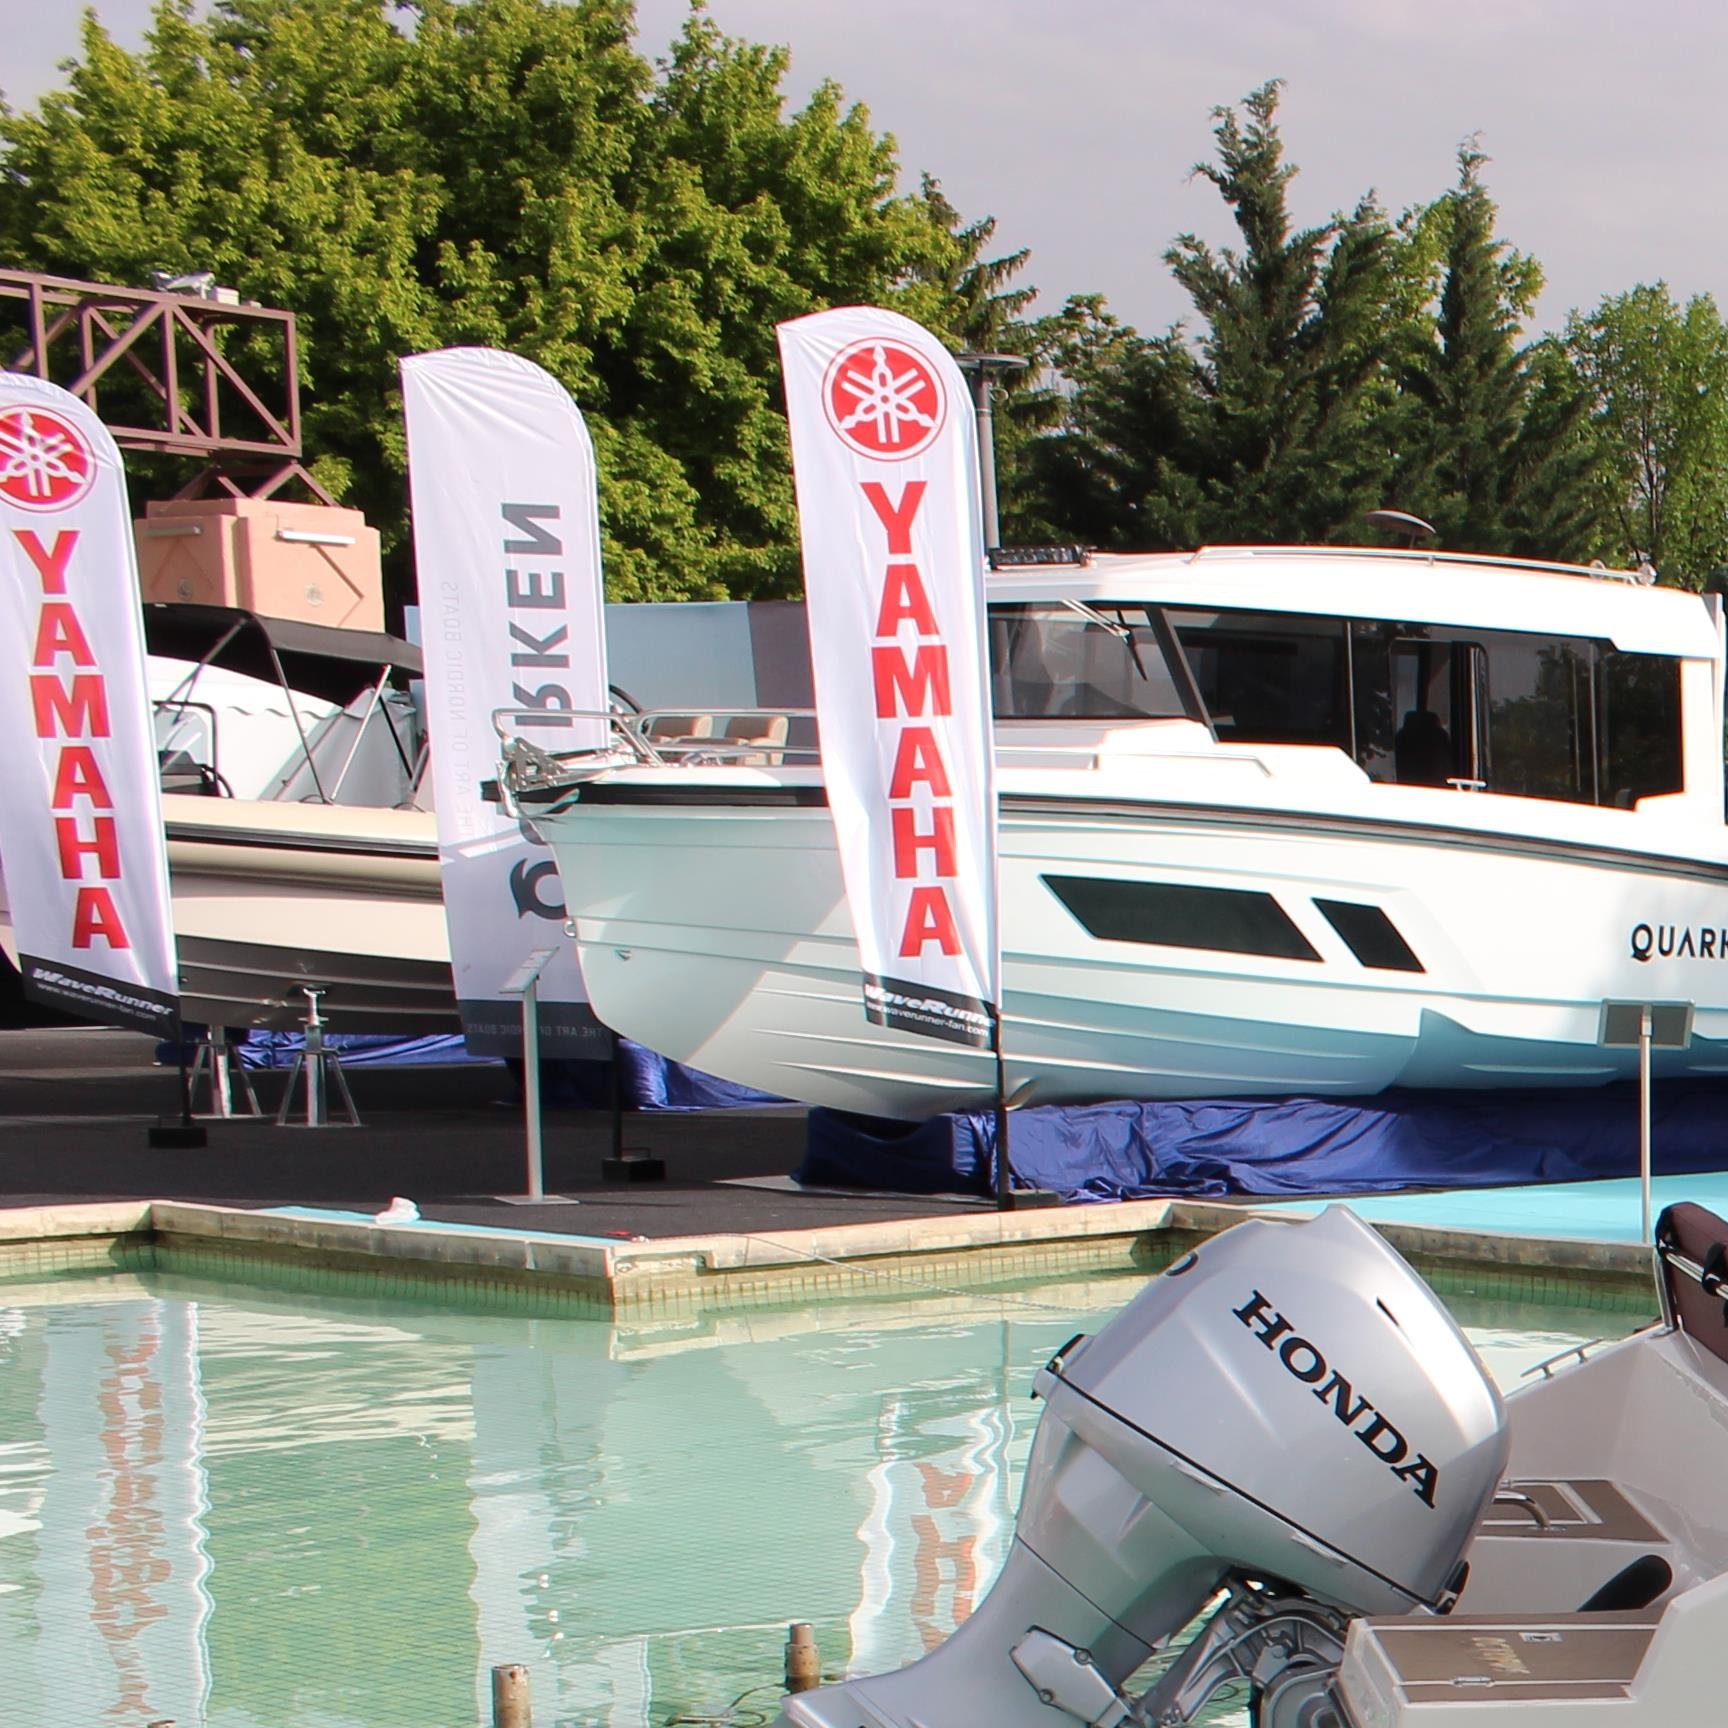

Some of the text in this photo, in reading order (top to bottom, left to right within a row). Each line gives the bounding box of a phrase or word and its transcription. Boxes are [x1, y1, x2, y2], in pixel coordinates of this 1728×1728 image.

[14, 530, 129, 949] YAMAHA
[861, 481, 961, 957] YAMAHA
[1232, 1290, 1440, 1510] HONDA
